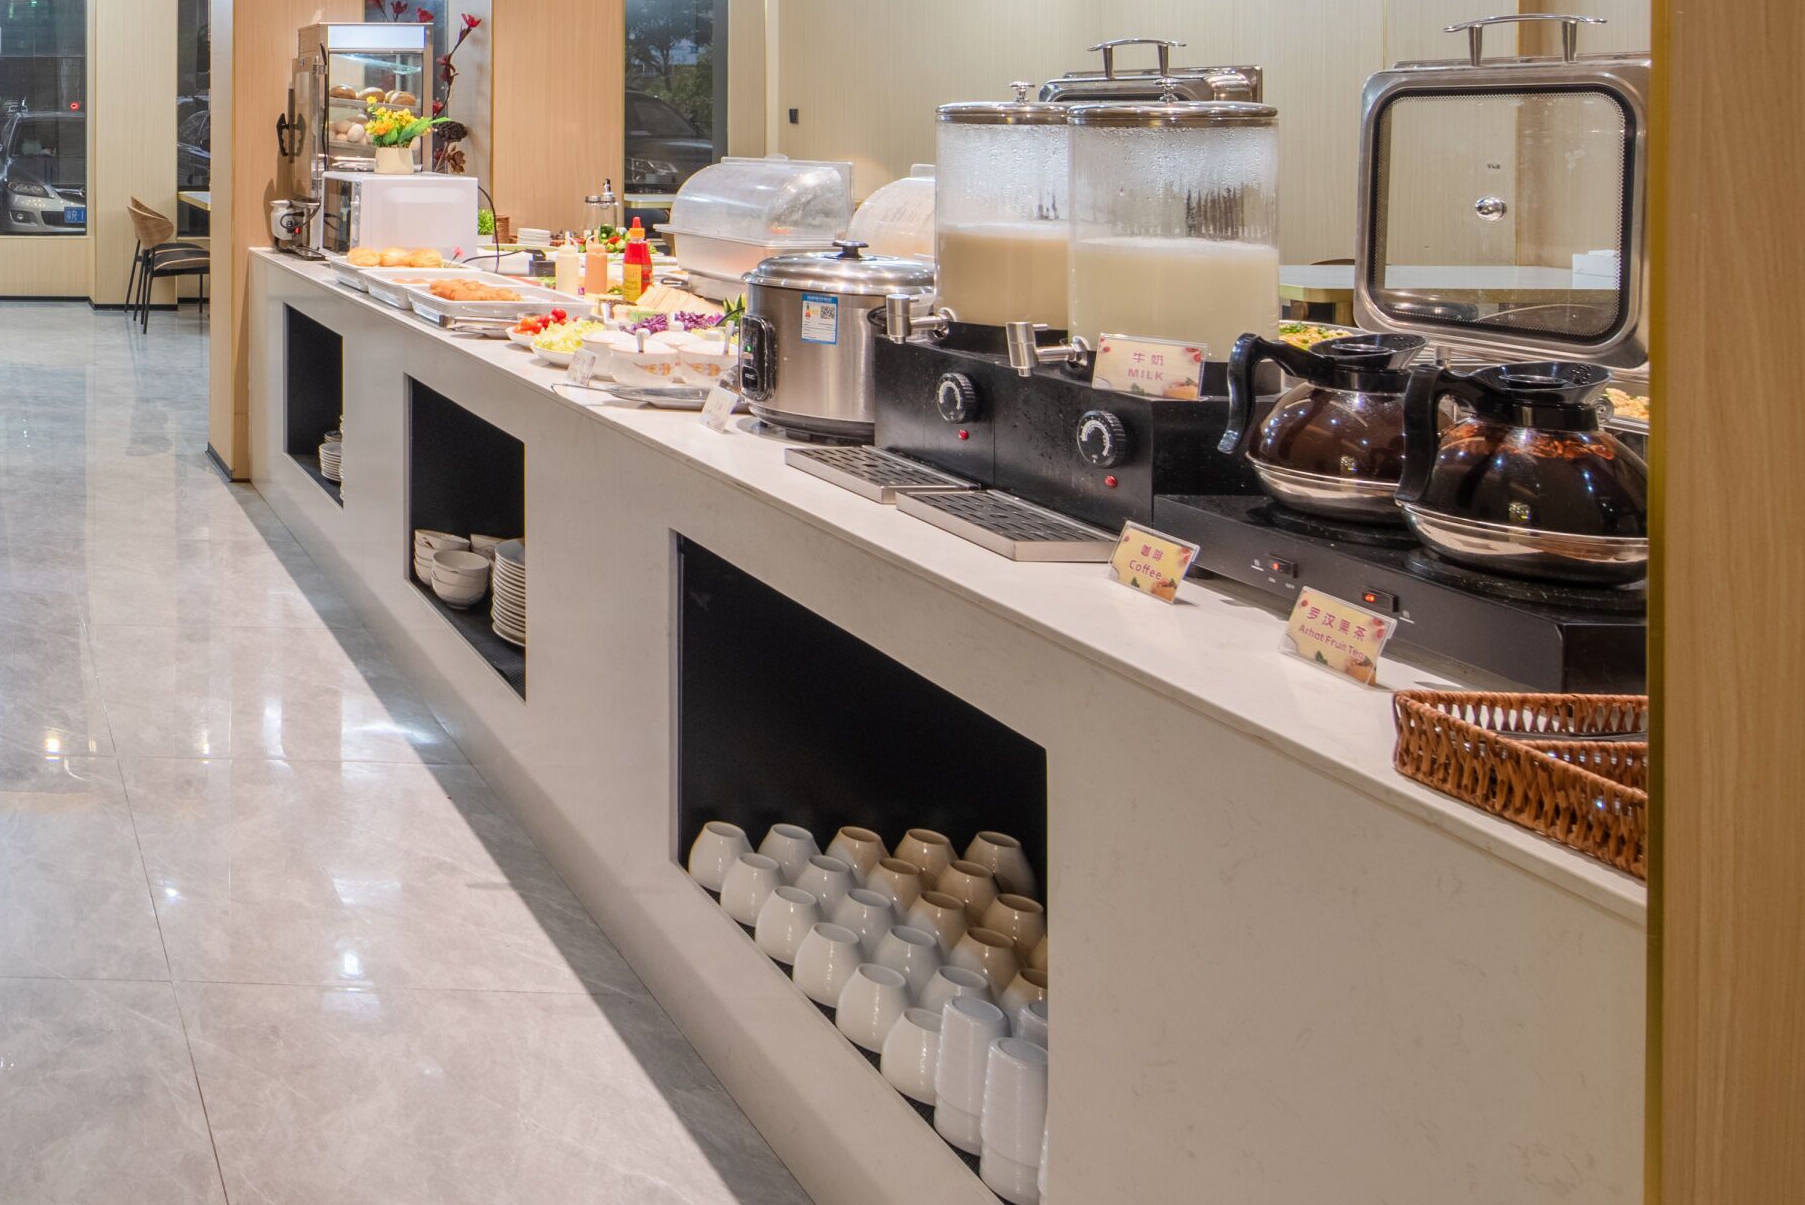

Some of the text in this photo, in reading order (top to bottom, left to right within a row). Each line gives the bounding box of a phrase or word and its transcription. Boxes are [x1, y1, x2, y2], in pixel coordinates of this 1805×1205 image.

[1132, 351, 1164, 366] 牛奶
[1128, 368, 1164, 381] MILK
[1140, 544, 1164, 562] 咖啡
[1129, 559, 1163, 580] Coffee
[1306, 606, 1367, 642] 罗汉果茶
[1298, 623, 1365, 663] Arhat Fruit Tea
